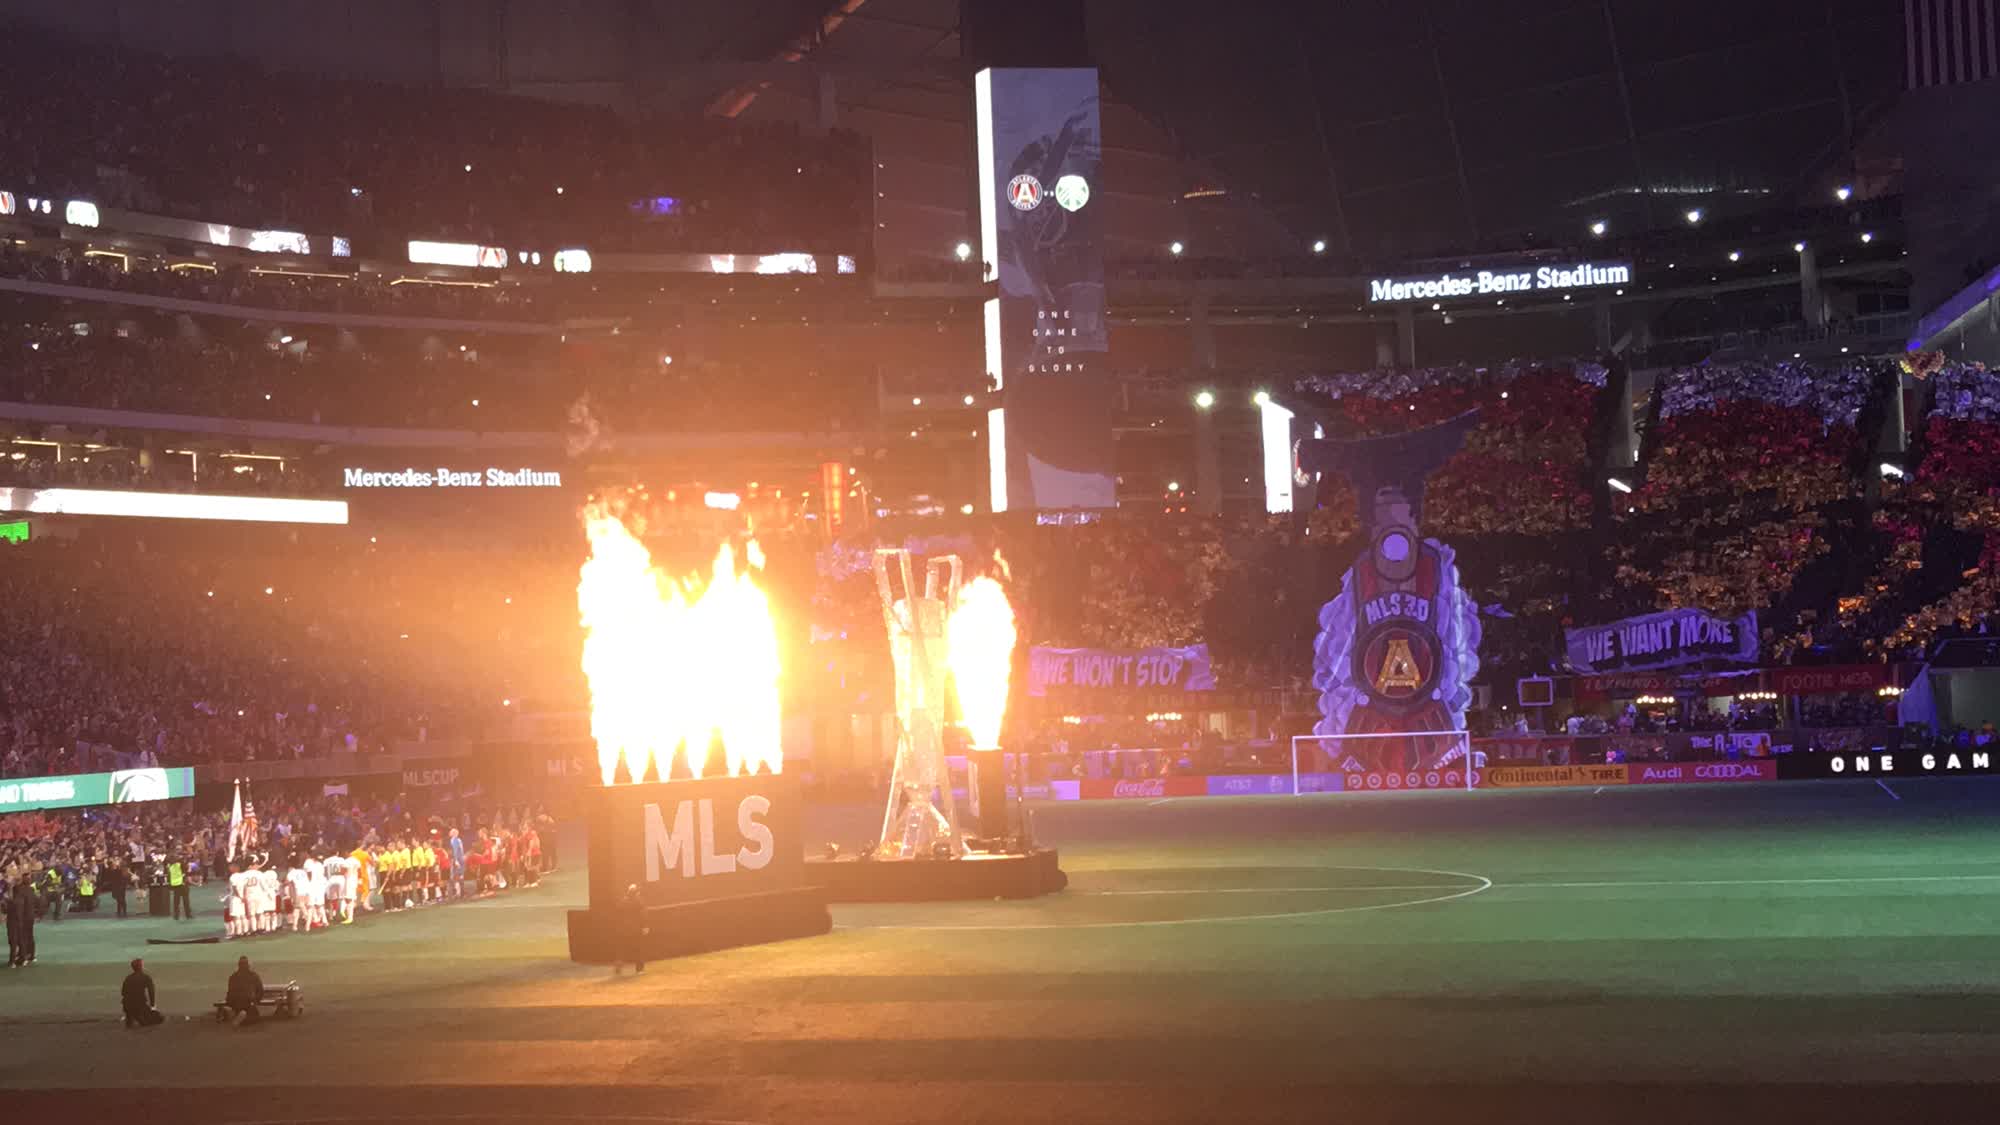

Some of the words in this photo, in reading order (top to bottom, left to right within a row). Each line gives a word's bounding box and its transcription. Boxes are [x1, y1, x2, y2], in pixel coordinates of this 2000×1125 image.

[1371, 270, 1532, 301] Mercedes-Benz
[1536, 264, 1629, 289] Stadium
[1038, 310, 1071, 319] ONE
[1032, 328, 1077, 337] GAME
[1047, 345, 1065, 354] TO
[1028, 363, 1084, 373] GLORY
[344, 468, 482, 487] Mercedes-Benz
[486, 468, 562, 487] Stadium
[1365, 592, 1401, 624] MLS
[1584, 631, 1615, 663] WE
[1618, 619, 1674, 657] WANT
[1678, 615, 1733, 648] MORE
[1047, 656, 1071, 685] WE
[1073, 655, 1133, 688] WON'T
[1135, 655, 1185, 687] STOP
[1831, 756, 1894, 773] ONE
[1921, 752, 1990, 770] GAM
[1488, 767, 1573, 786] Continental
[1588, 768, 1625, 781] TIRE
[1643, 767, 1683, 780] Audi
[643, 795, 774, 882] MLS
